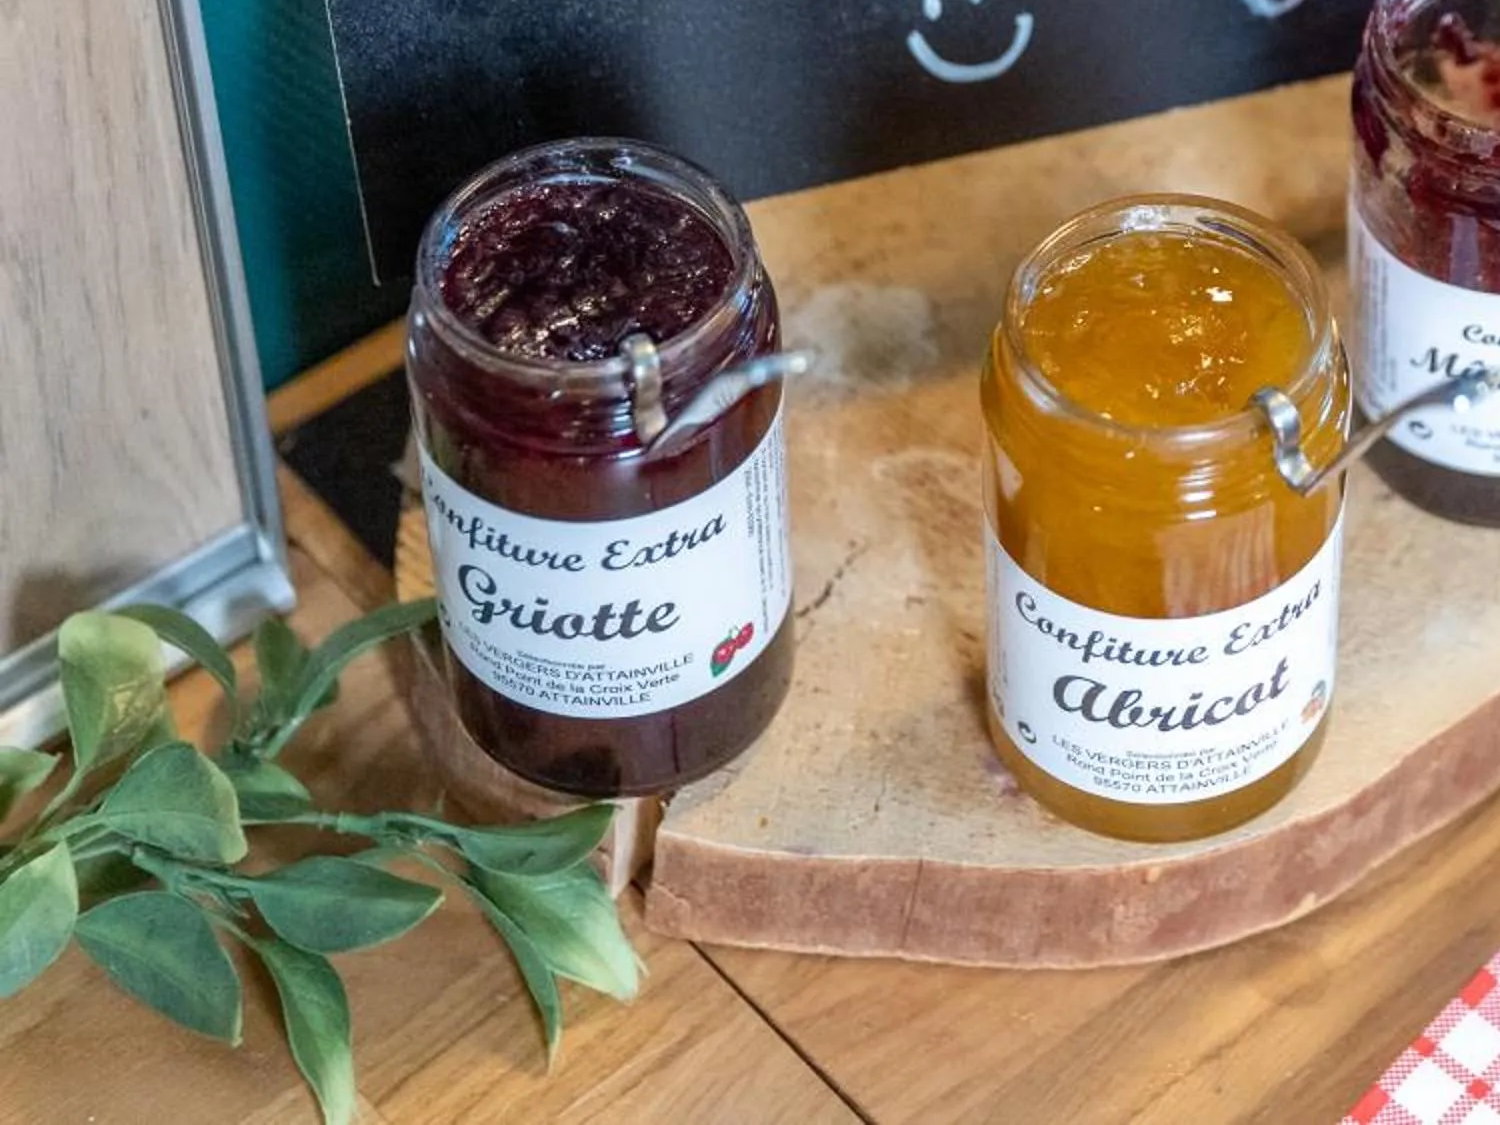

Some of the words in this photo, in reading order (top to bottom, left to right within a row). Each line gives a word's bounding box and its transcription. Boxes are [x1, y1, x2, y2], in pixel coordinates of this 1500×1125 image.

[601, 512, 727, 571] Extra
[457, 564, 681, 641] Griotte
[1016, 591, 1209, 666] Confiture
[1224, 579, 1322, 655] Extra
[483, 641, 561, 680] VERGERS
[565, 652, 693, 683] D'ATTAINVILLE
[546, 677, 566, 692] de
[569, 681, 586, 694] la
[590, 677, 633, 695] Croix
[636, 672, 680, 691] Verte
[539, 690, 651, 707] ATTAINVILLE
[1053, 656, 1290, 732] Abricot
[1052, 733, 1081, 756] LES
[1084, 749, 1172, 771] VERGERS
